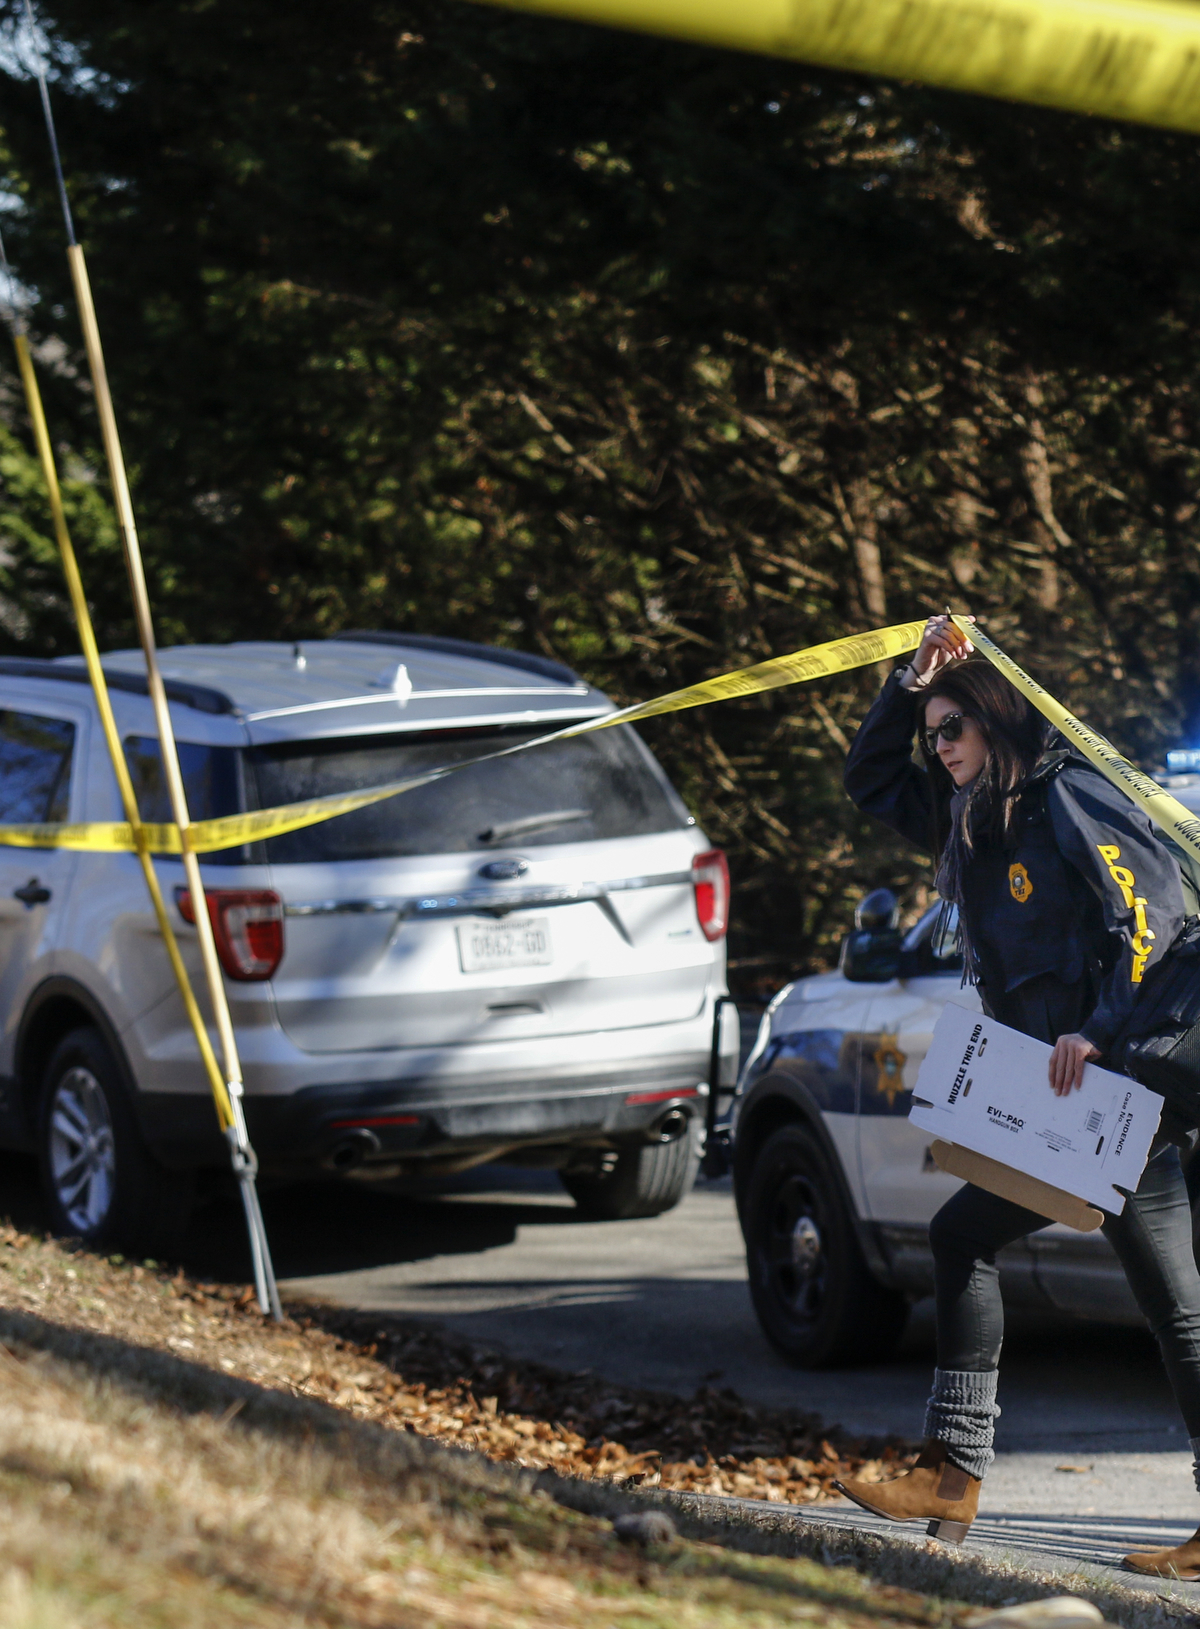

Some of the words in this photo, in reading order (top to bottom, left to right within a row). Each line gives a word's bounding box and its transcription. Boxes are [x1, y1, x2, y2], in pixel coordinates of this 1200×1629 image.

[1096, 844, 1157, 983] POLICE
[947, 1067, 967, 1105] MUZZLE
[961, 1044, 975, 1065] THIS
[970, 1023, 983, 1043] END
[1122, 1092, 1132, 1110] Case
[1114, 1113, 1134, 1156] EVIDENCE
